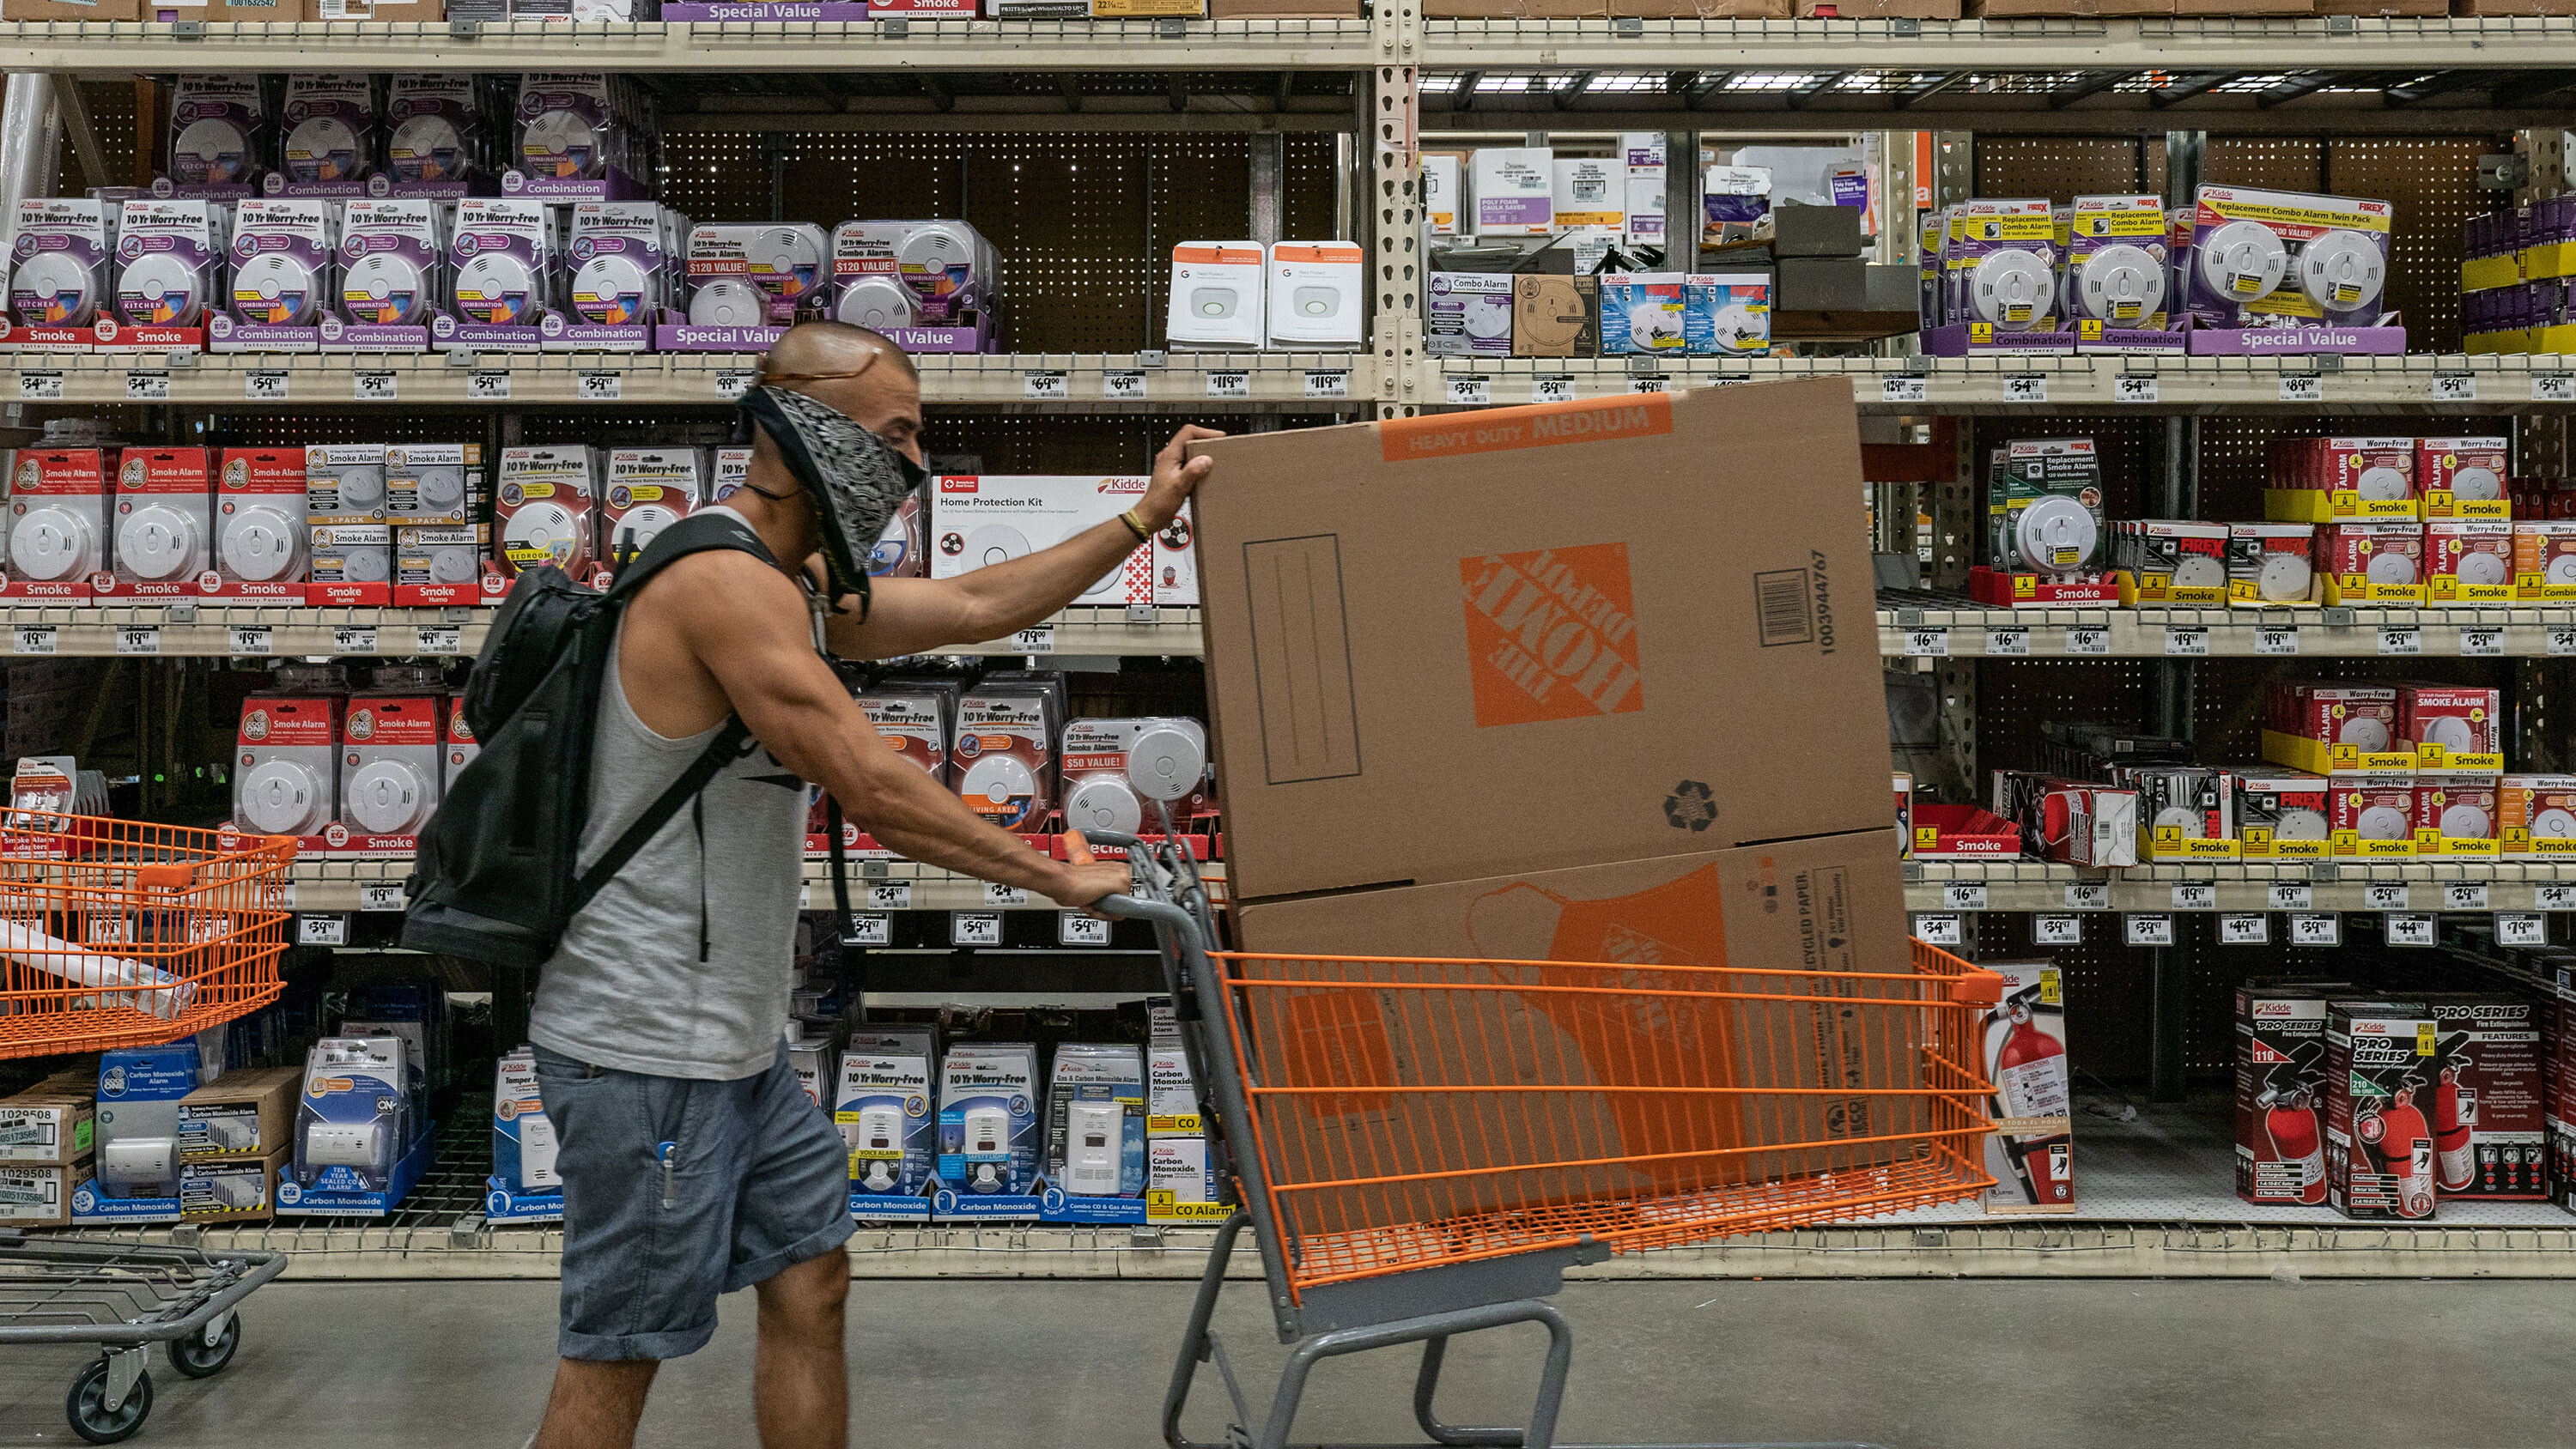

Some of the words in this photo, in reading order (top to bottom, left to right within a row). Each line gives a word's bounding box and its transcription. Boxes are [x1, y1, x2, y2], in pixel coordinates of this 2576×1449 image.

[709, 5, 768, 20] Special
[775, 5, 820, 18] Value
[289, 185, 360, 195] Combination
[394, 189, 465, 197] Combination
[527, 184, 600, 193] Combination
[178, 191, 249, 199] Combination
[2216, 203, 2269, 214] Replacement
[2272, 207, 2301, 215] Combo
[2359, 203, 2385, 215] FIREX
[21, 214, 32, 222] 10
[33, 214, 44, 222] Yr
[45, 214, 98, 224] Worry-Free
[243, 214, 253, 222] 10
[255, 214, 265, 222] Yr
[266, 214, 319, 224] Worry-Free
[463, 213, 473, 221] 10
[475, 213, 485, 221] Yr
[487, 214, 539, 223] Worry-Free
[2288, 228, 2312, 238] VALUE!
[690, 264, 712, 273] $120
[714, 263, 745, 273] VALUE!
[836, 263, 860, 273] $120
[862, 262, 894, 271] VALUE!
[1454, 279, 1481, 288] Combo
[30, 330, 75, 341] Smoke
[137, 331, 181, 343] Smoke
[237, 329, 313, 340] Combination
[347, 332, 422, 343] Combination
[459, 330, 535, 341] Combination
[677, 330, 737, 344] Special
[907, 331, 953, 344] Value
[1996, 336, 2071, 345] Combination
[2242, 332, 2303, 348] Special
[2309, 332, 2358, 346] Value
[1409, 432, 1467, 452] HEAVY
[1476, 425, 1522, 445] DUTY
[1533, 405, 1649, 438] MEDIUM
[2020, 445, 2038, 453] Kidde
[2071, 443, 2092, 452] FIREX
[2366, 440, 2408, 449] Worry-Free
[329, 454, 354, 463] Smoke
[506, 463, 516, 471] 10
[518, 463, 529, 472] Yr
[530, 461, 583, 473] Worry-Free
[73, 469, 96, 477] Alarm
[1112, 479, 1145, 490] Kidde
[940, 498, 969, 506] Home
[973, 497, 1026, 507] Protection
[1029, 497, 1042, 506] Kit
[2368, 502, 2408, 513] Smoke
[2265, 537, 2310, 556] FIREX
[27, 584, 71, 595] Smoke
[327, 586, 361, 597] Smoke
[2056, 589, 2100, 599] Smoke
[2377, 587, 2416, 597] Smoke
[1524, 549, 1637, 647] DEPOT
[1811, 549, 1836, 656] 1003944767
[1462, 555, 1640, 715] HOME
[1486, 639, 1558, 704] THE
[2349, 690, 2391, 699] Worry-Free
[2418, 698, 2451, 706] SMOKE
[2452, 698, 2484, 706] ALARM
[963, 712, 974, 722] 10
[975, 712, 986, 722] Yr
[987, 712, 1040, 724] Worry-Free
[1066, 758, 1085, 768] $50
[1088, 757, 1120, 767] VALUE!
[2368, 757, 2408, 767] Smoke
[368, 838, 413, 848] Smoke
[1956, 840, 2002, 851] Smoke
[2266, 1003, 2291, 1012] Kidde
[2433, 1006, 2471, 1019] PRO
[2472, 1005, 2529, 1018] SERIES
[2257, 1021, 2282, 1030] PRO
[2282, 1021, 2322, 1030] SERIES
[2256, 1051, 2274, 1060] 110
[848, 1073, 859, 1082] 10
[860, 1073, 871, 1083] Yr
[872, 1073, 924, 1085] Worry-Free
[378, 1100, 392, 1110] ON
[883, 1202, 927, 1210] Monoxide
[1176, 1206, 1194, 1216] CO
[1195, 1206, 1232, 1215] Alarm
